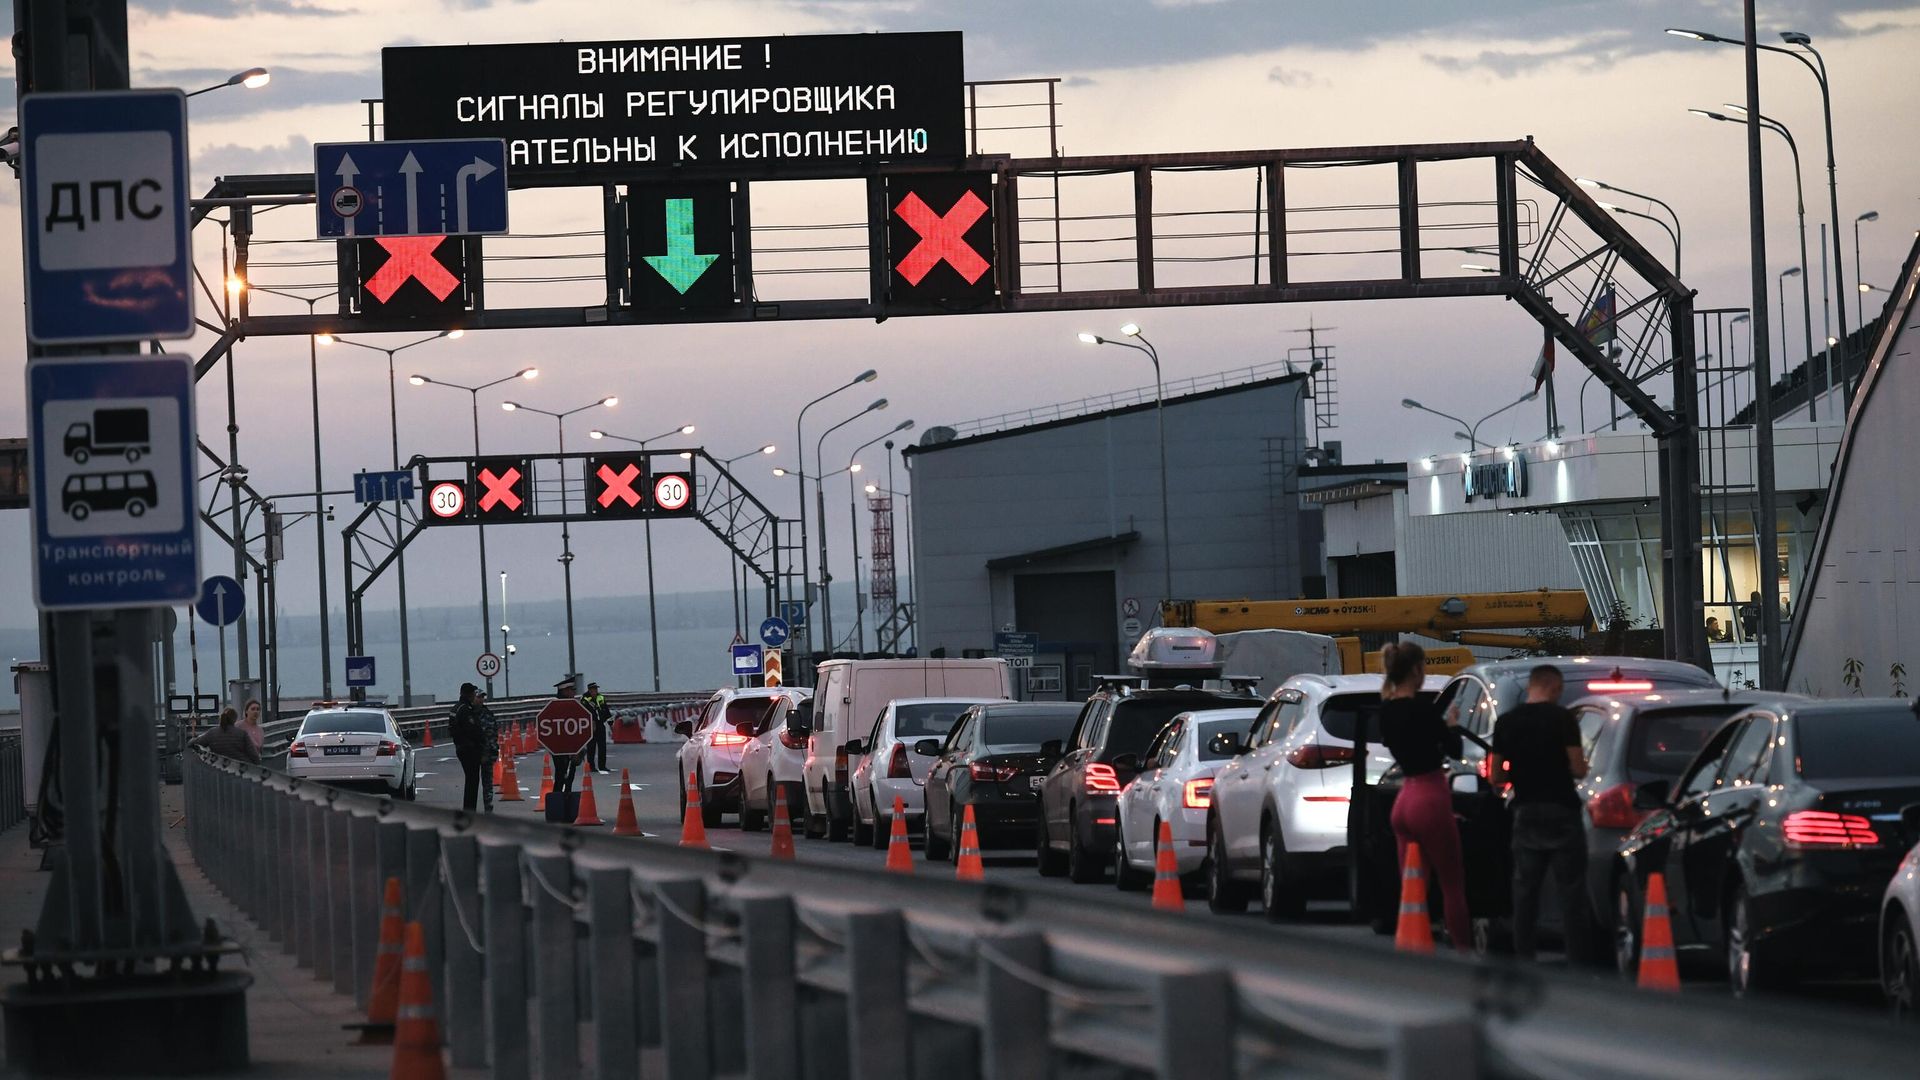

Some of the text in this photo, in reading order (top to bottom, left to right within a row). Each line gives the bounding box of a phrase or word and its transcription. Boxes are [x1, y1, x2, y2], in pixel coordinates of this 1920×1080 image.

[578, 44, 771, 74] ВНИМАНИЕ !
[457, 84, 895, 122] СИГНАЛЫ РЕГУЛИРОВЩИКА
[510, 128, 928, 165] АТЕЛЬНЫ К ИСПОЛНЕНИЮ
[45, 178, 163, 233] ДПС
[437, 491, 457, 509] 30
[661, 483, 682, 500] 30
[41, 539, 192, 563] Транспортный
[68, 569, 167, 587] контроль
[482, 660, 496, 670] 30
[540, 718, 590, 737] STOP
